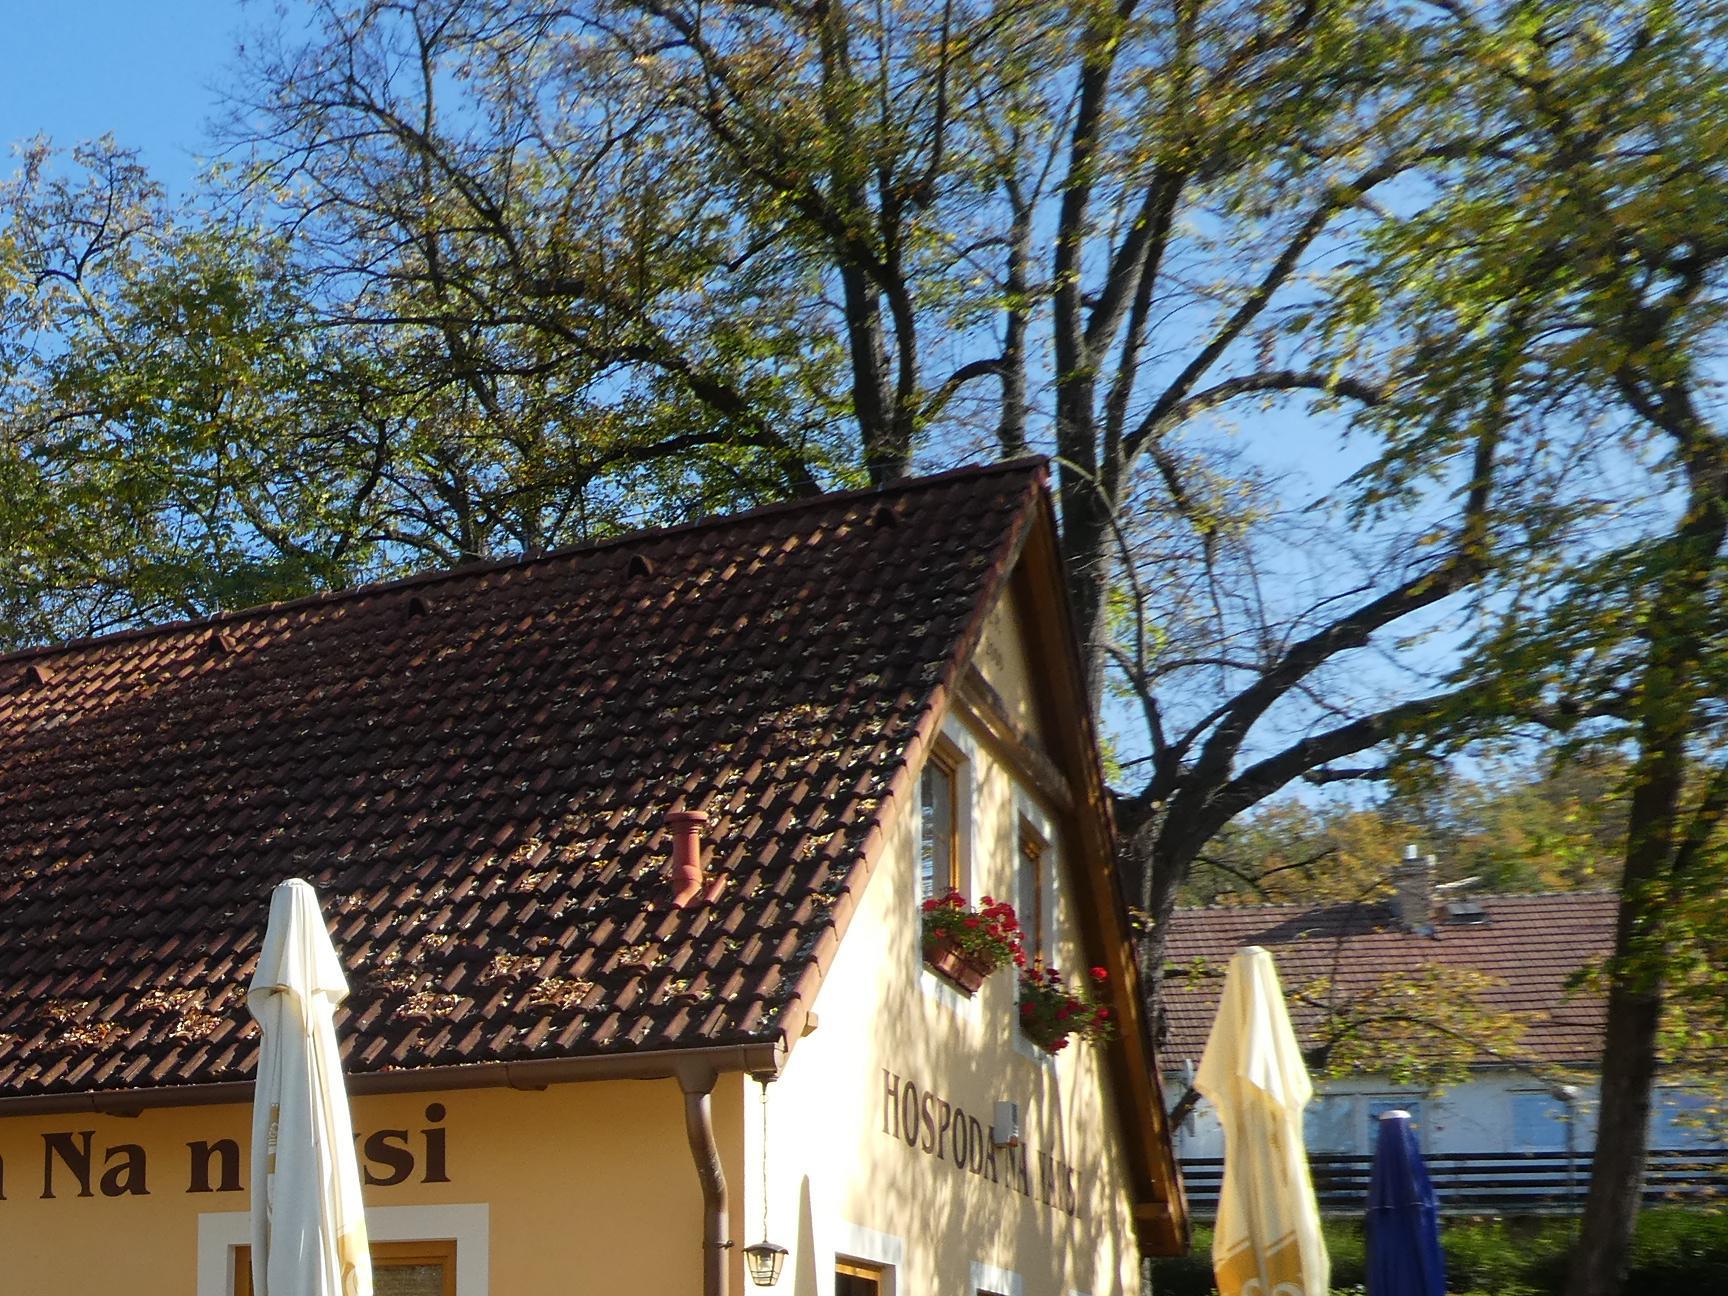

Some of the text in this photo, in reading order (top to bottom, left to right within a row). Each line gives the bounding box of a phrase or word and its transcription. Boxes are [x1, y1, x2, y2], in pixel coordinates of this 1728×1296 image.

[40, 1129, 151, 1198] Na
[185, 1102, 452, 1193] nsi
[882, 1068, 998, 1184] HOSPODA
